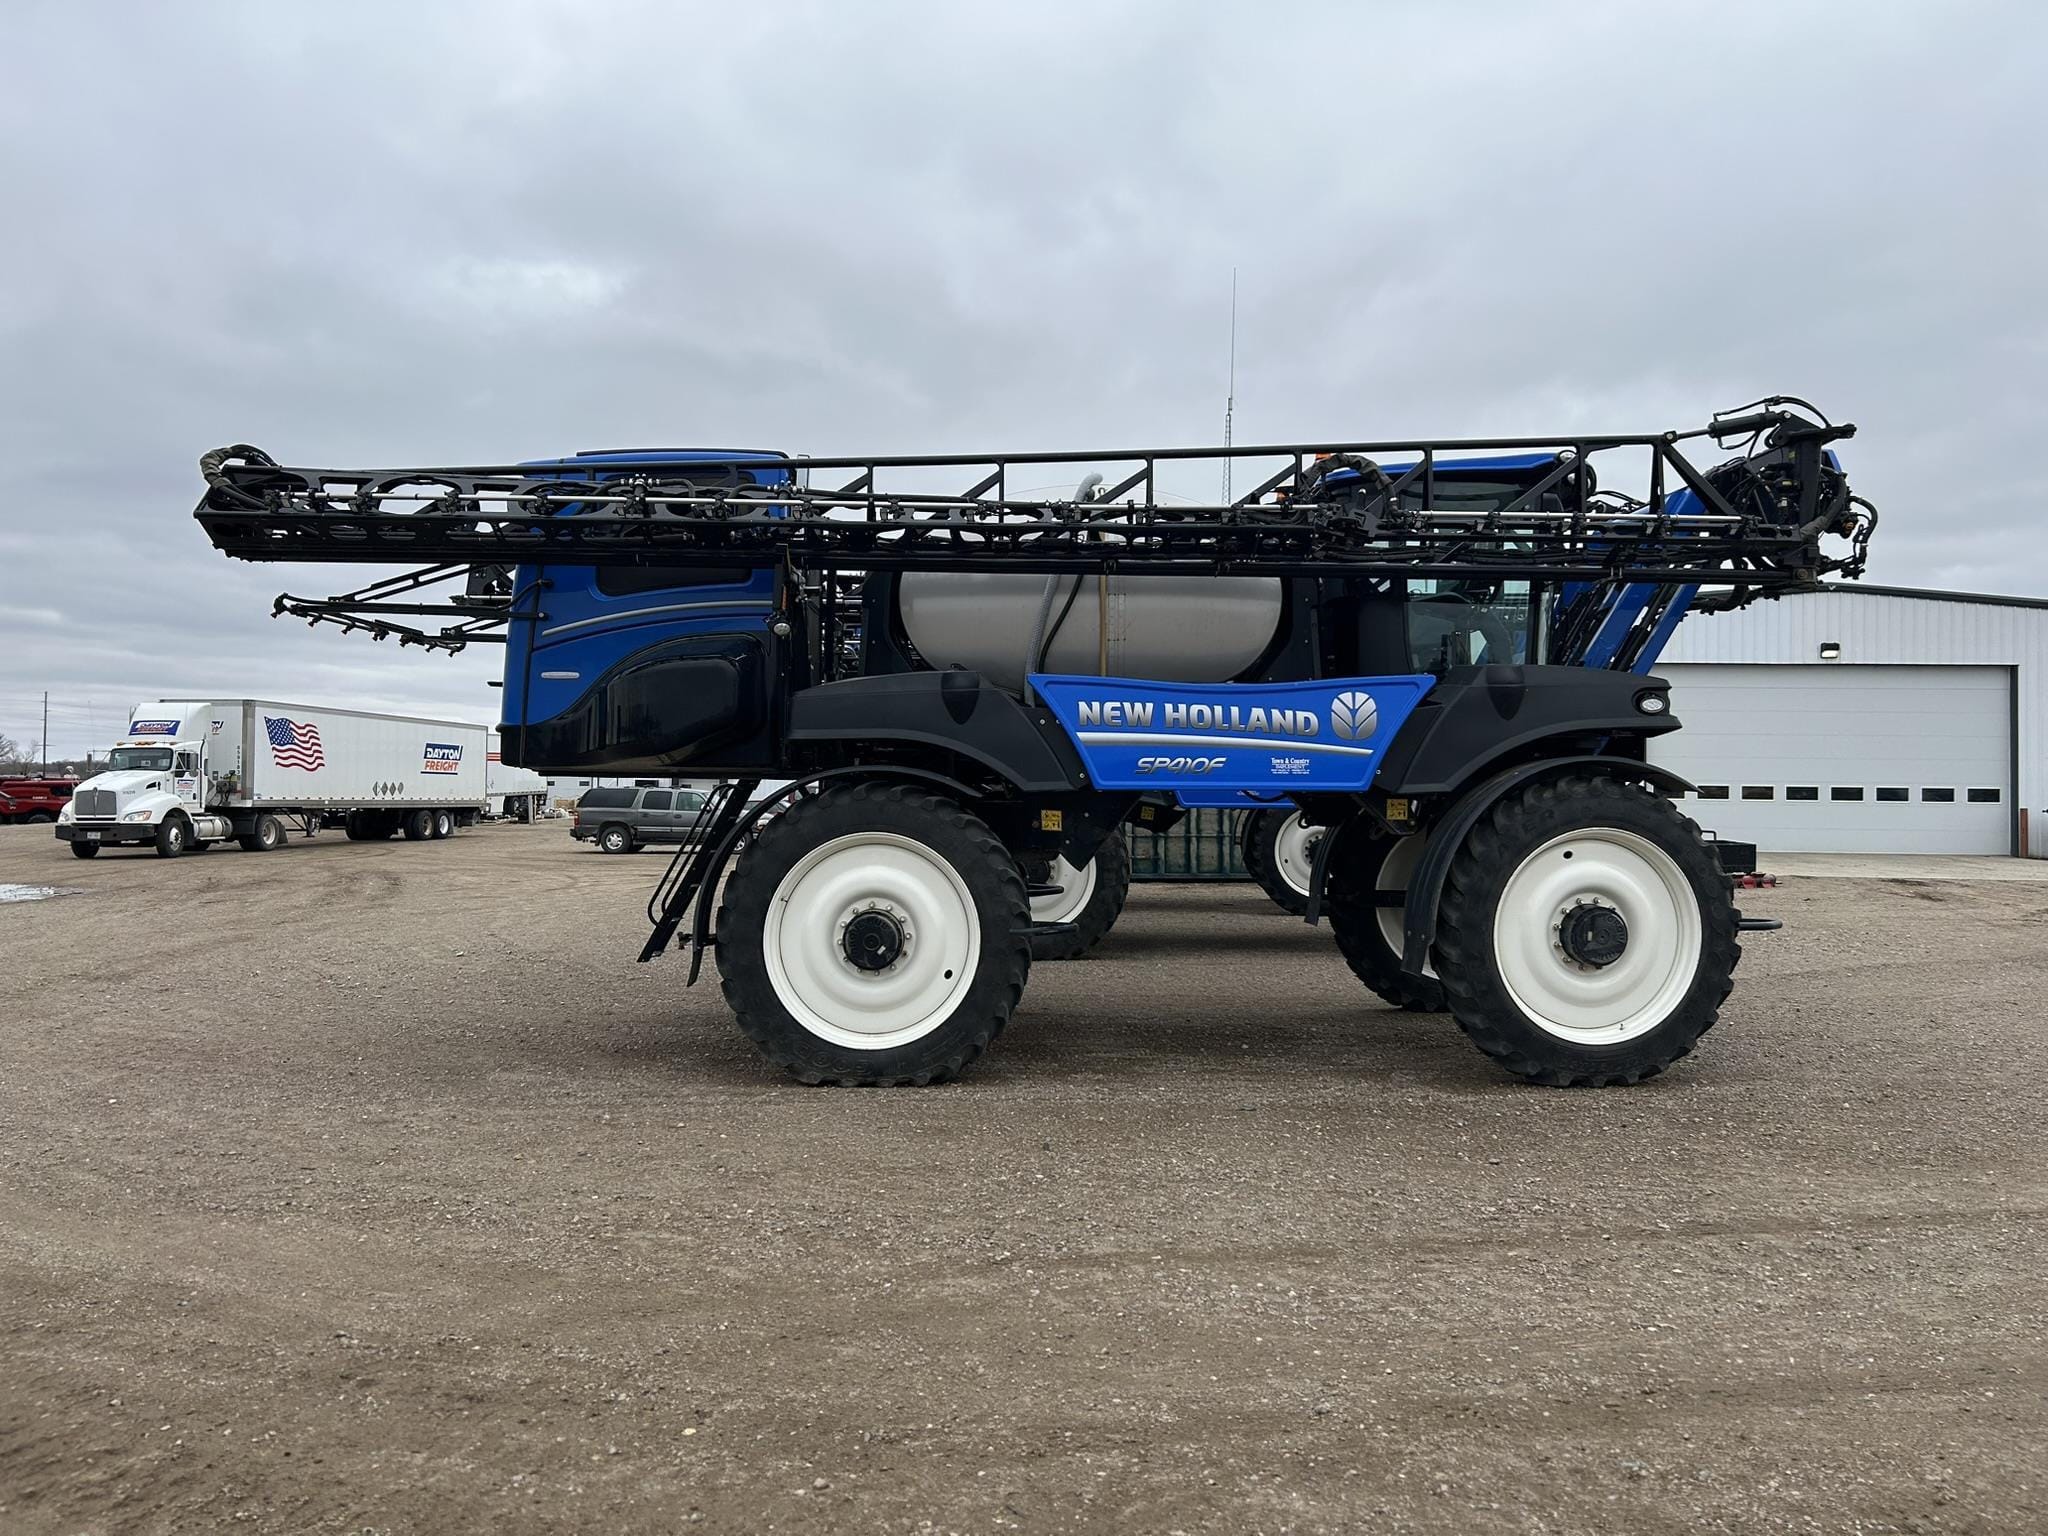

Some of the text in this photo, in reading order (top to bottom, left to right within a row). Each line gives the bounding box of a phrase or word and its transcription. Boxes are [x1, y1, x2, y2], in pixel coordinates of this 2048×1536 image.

[1078, 701, 1320, 736] NEW HOLLAND
[426, 745, 462, 760] DAYTON
[425, 761, 459, 771] FREIGHT
[1135, 757, 1228, 775] SP410F
